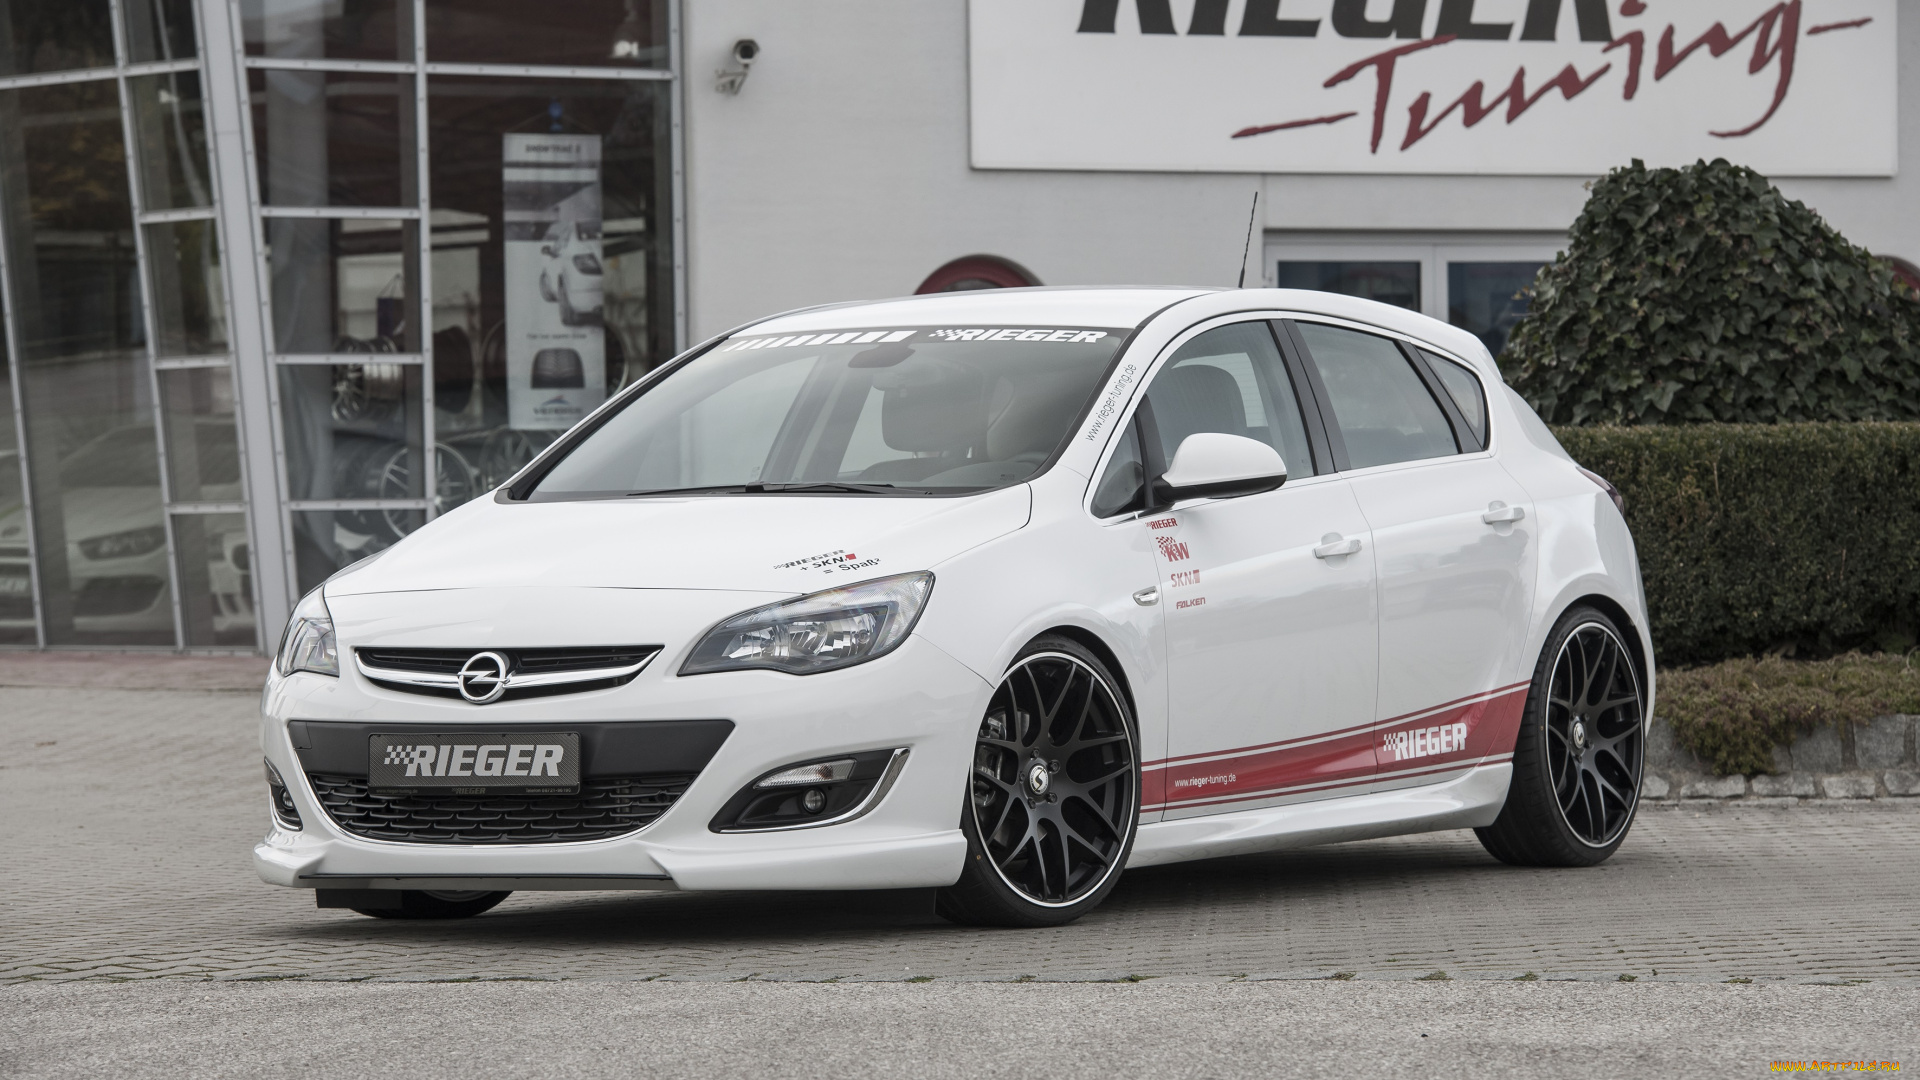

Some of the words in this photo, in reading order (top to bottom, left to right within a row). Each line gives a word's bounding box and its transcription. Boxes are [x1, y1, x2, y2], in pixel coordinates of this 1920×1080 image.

[945, 328, 1108, 343] RIEGER
[1085, 363, 1137, 442] www.rieger-tuning.de
[1150, 518, 1178, 530] RIEGER
[784, 549, 846, 568] RIEGER
[1164, 541, 1190, 562] KW
[1176, 597, 1206, 609] FALKEN
[1395, 722, 1468, 761] RIEGER
[404, 744, 564, 777] RIEGER
[1174, 773, 1237, 787] www.rieger-tuning.de
[455, 787, 486, 795] RIEGER
